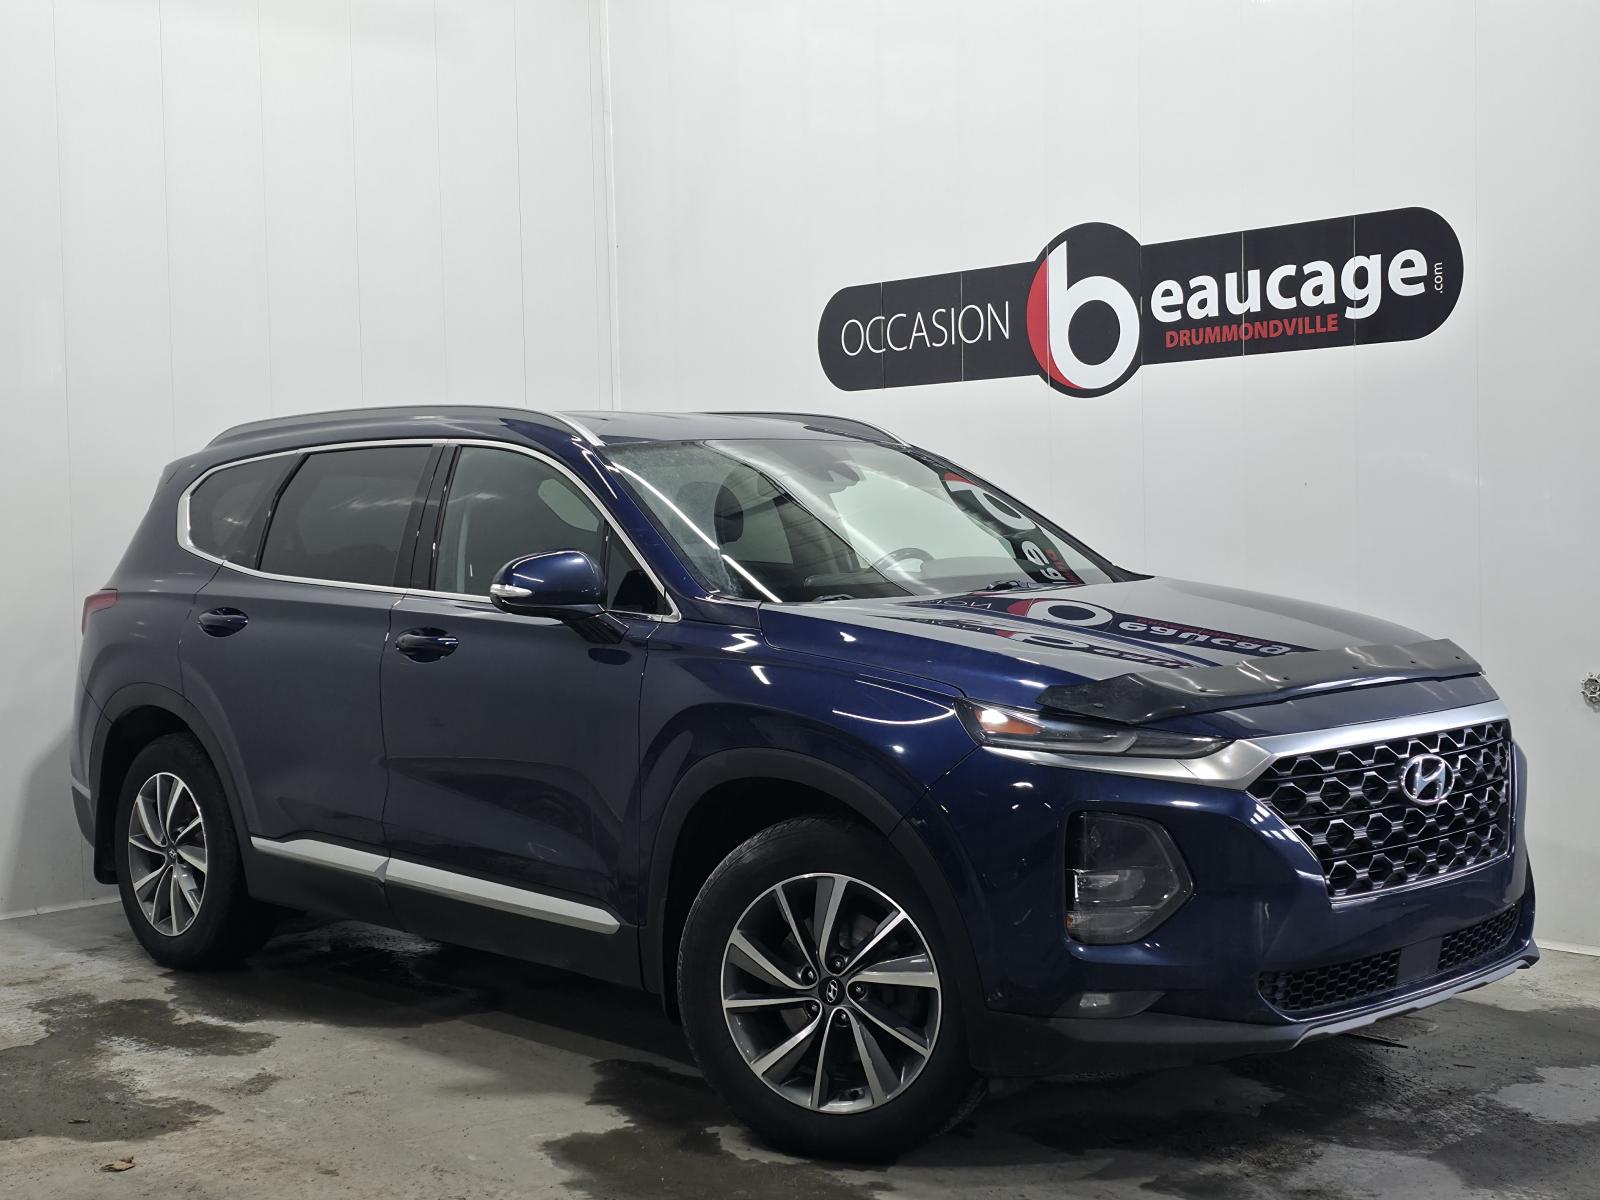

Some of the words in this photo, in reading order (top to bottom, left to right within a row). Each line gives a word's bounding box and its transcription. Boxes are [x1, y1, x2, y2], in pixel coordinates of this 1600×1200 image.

[841, 300, 1010, 356] OCCASION
[1434, 262, 1443, 294] .com
[1165, 313, 1339, 348] DRUMMONDVILLE
